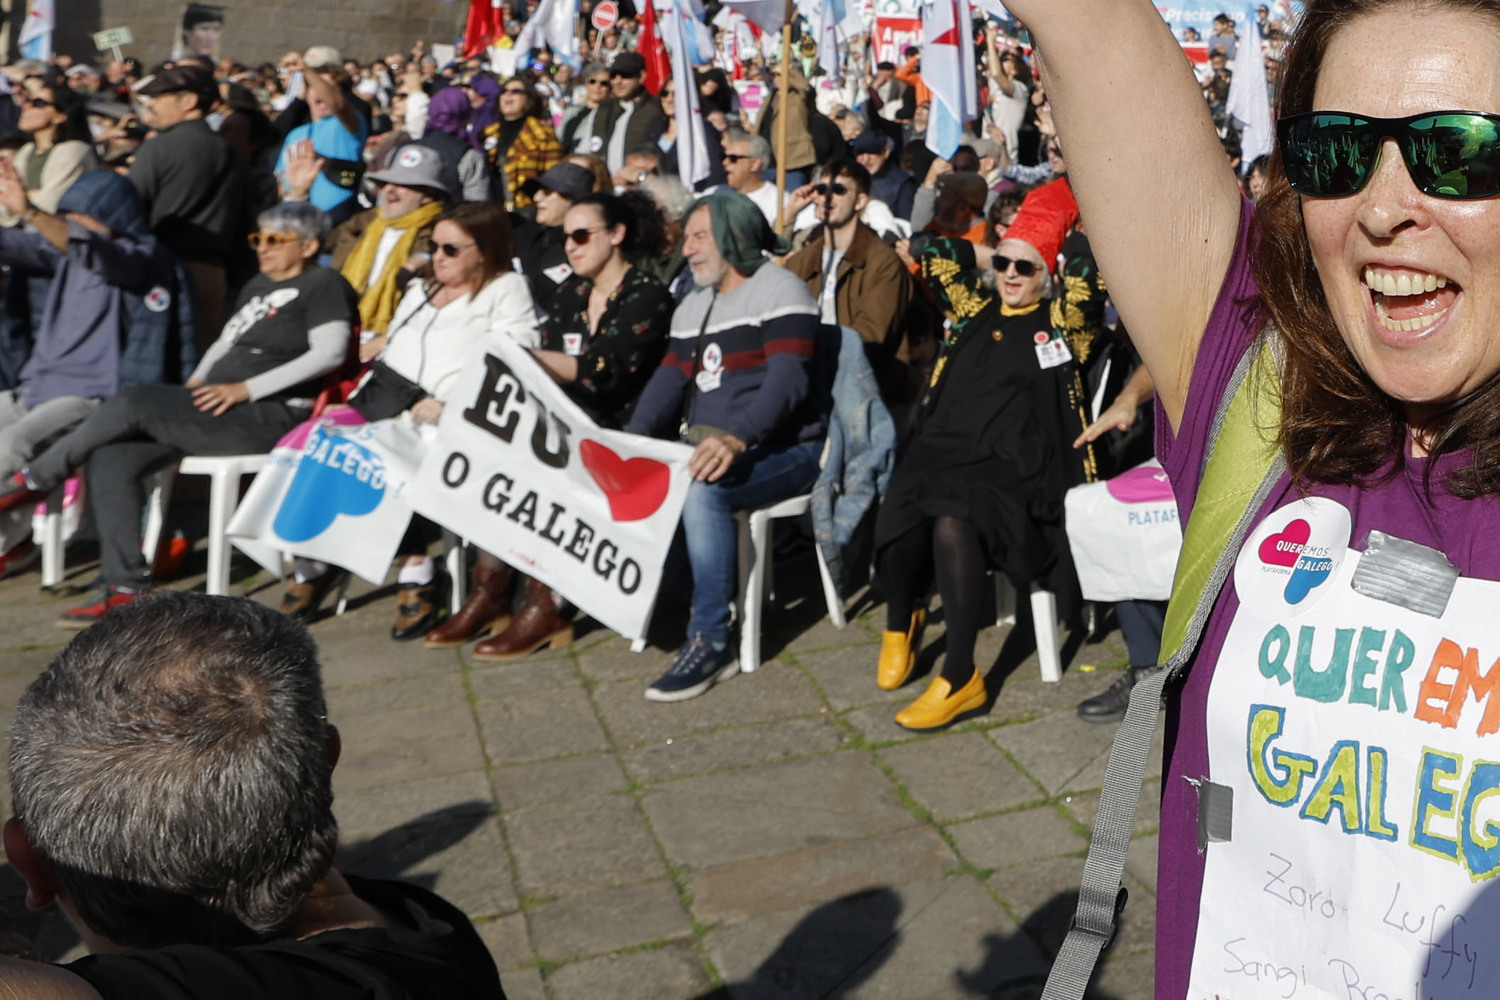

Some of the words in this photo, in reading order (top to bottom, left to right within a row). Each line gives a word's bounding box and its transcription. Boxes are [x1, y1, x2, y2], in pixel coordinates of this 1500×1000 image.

[463, 351, 573, 470] EU
[442, 451, 471, 490] O
[482, 472, 644, 596] GALEGO
[1276, 540, 1330, 557] QUEREMOS
[1263, 852, 1336, 919] Zoro
[1383, 882, 1477, 989] Luffy
